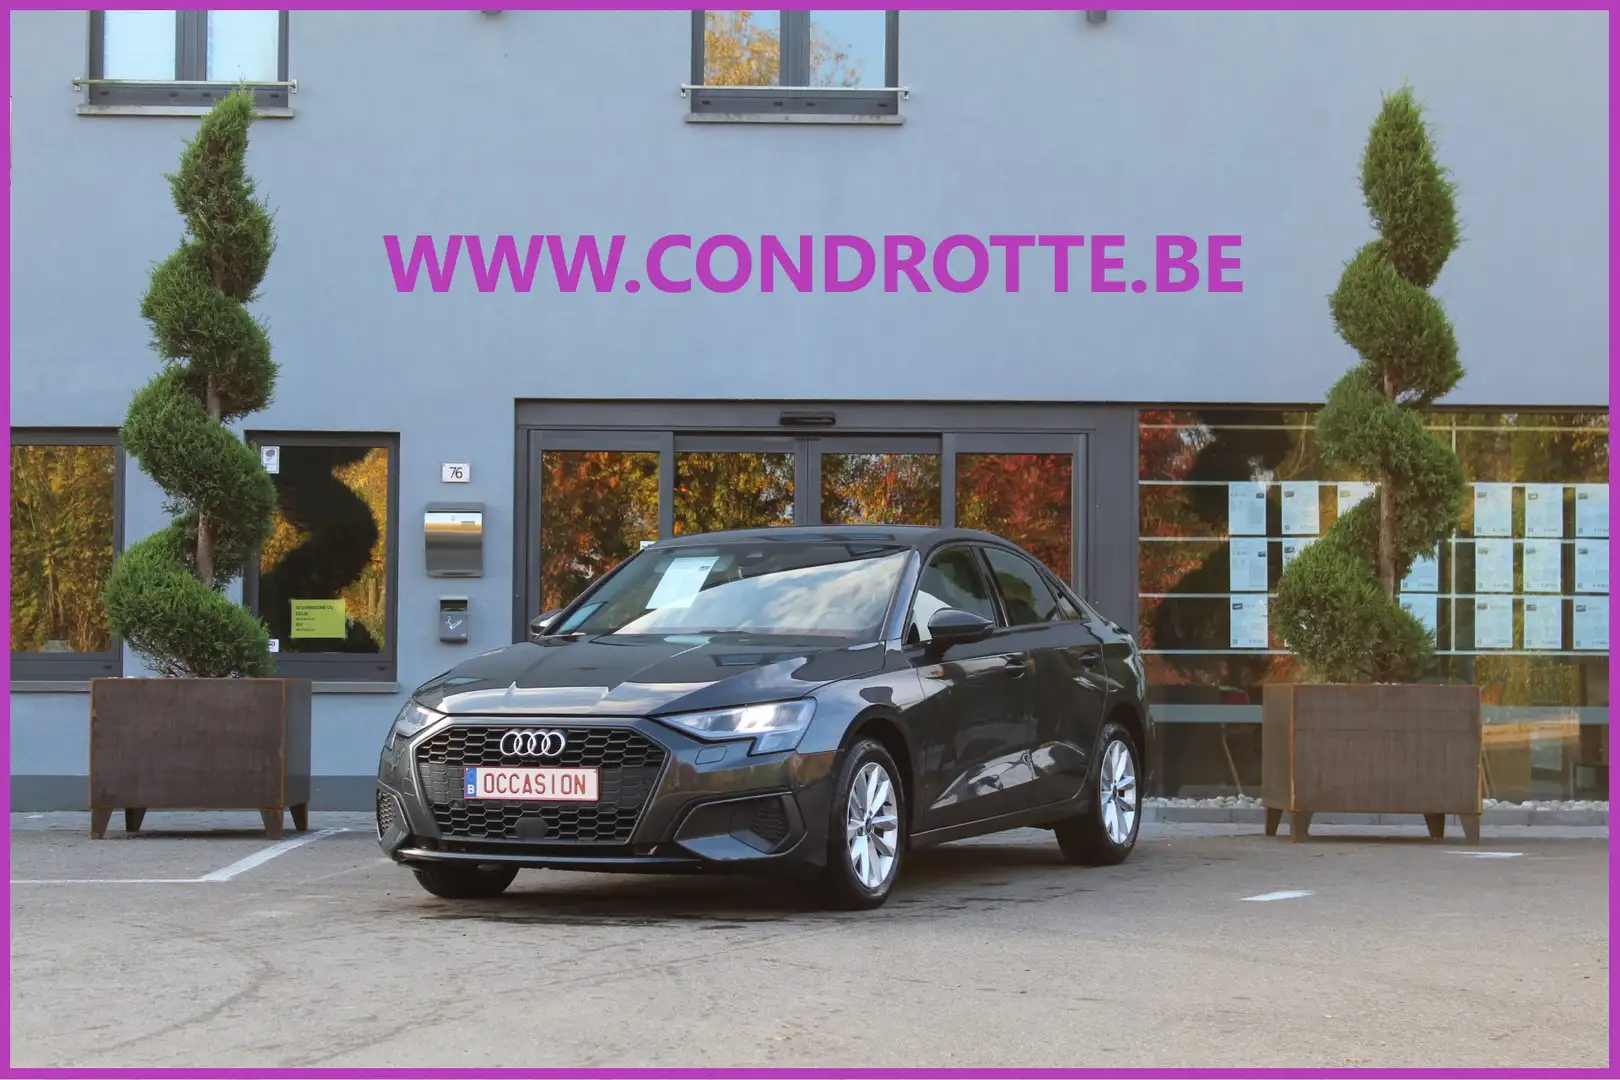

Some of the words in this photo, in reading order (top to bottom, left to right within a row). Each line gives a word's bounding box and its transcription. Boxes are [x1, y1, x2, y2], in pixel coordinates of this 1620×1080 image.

[449, 466, 463, 479] 76
[467, 784, 475, 794] B
[483, 772, 586, 795] OCCASION
